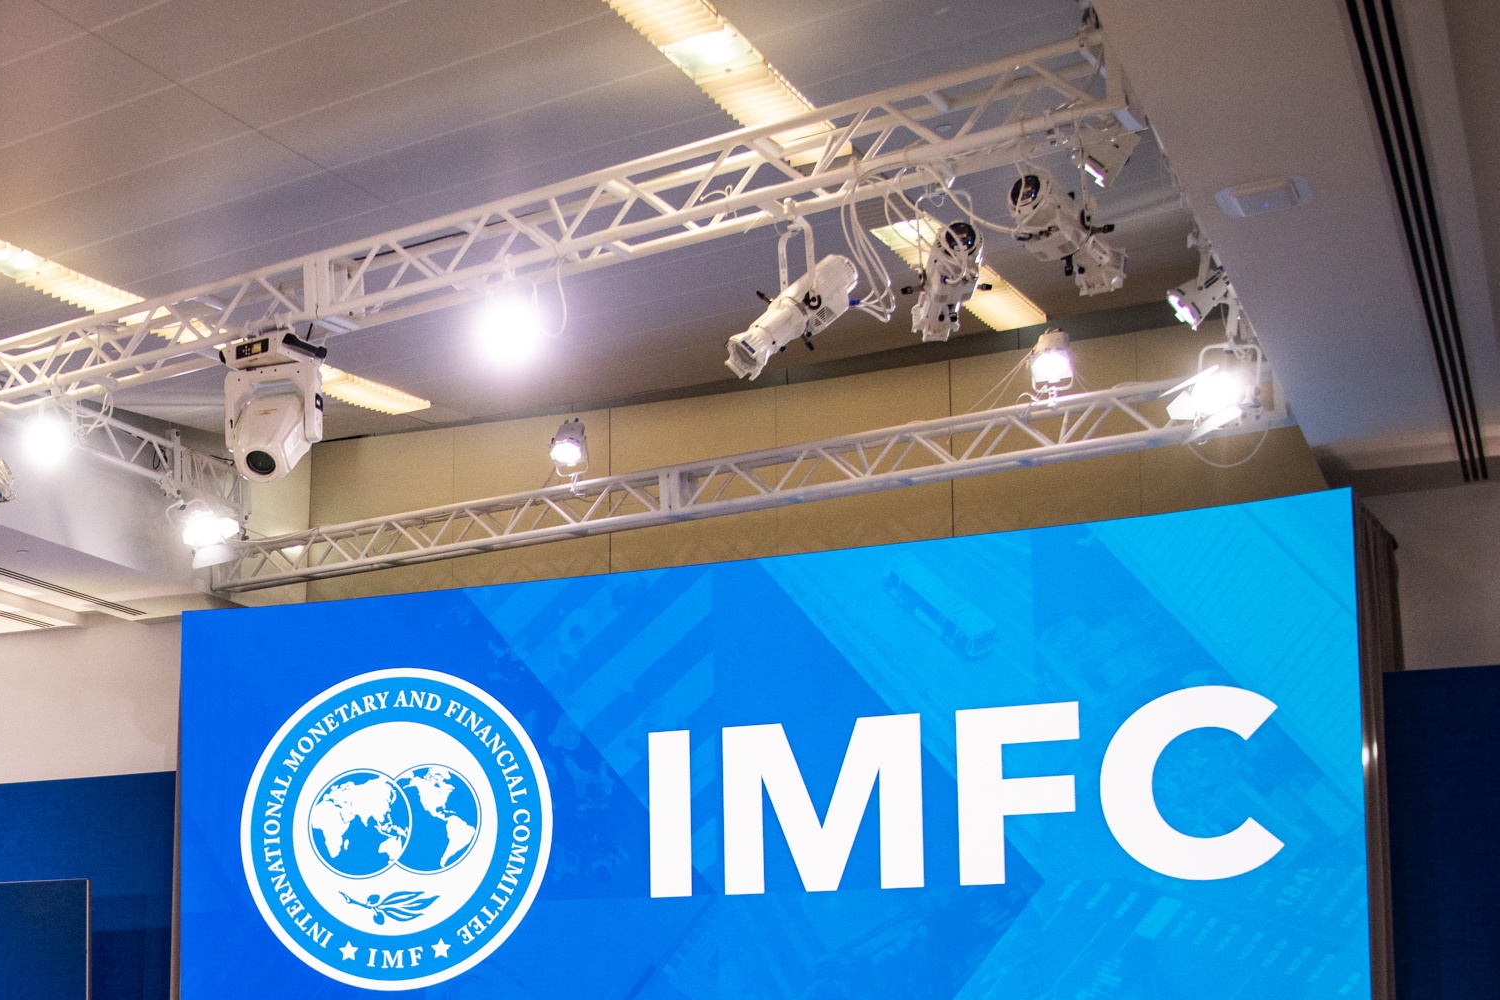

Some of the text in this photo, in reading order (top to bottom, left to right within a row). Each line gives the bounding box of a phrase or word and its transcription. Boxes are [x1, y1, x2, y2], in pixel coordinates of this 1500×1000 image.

[263, 690, 531, 948] INTERNATIONAL MONETARY AND FINANCIAL COMMITTEE
[648, 685, 1285, 899] IMFC
[366, 946, 424, 969] IMF
